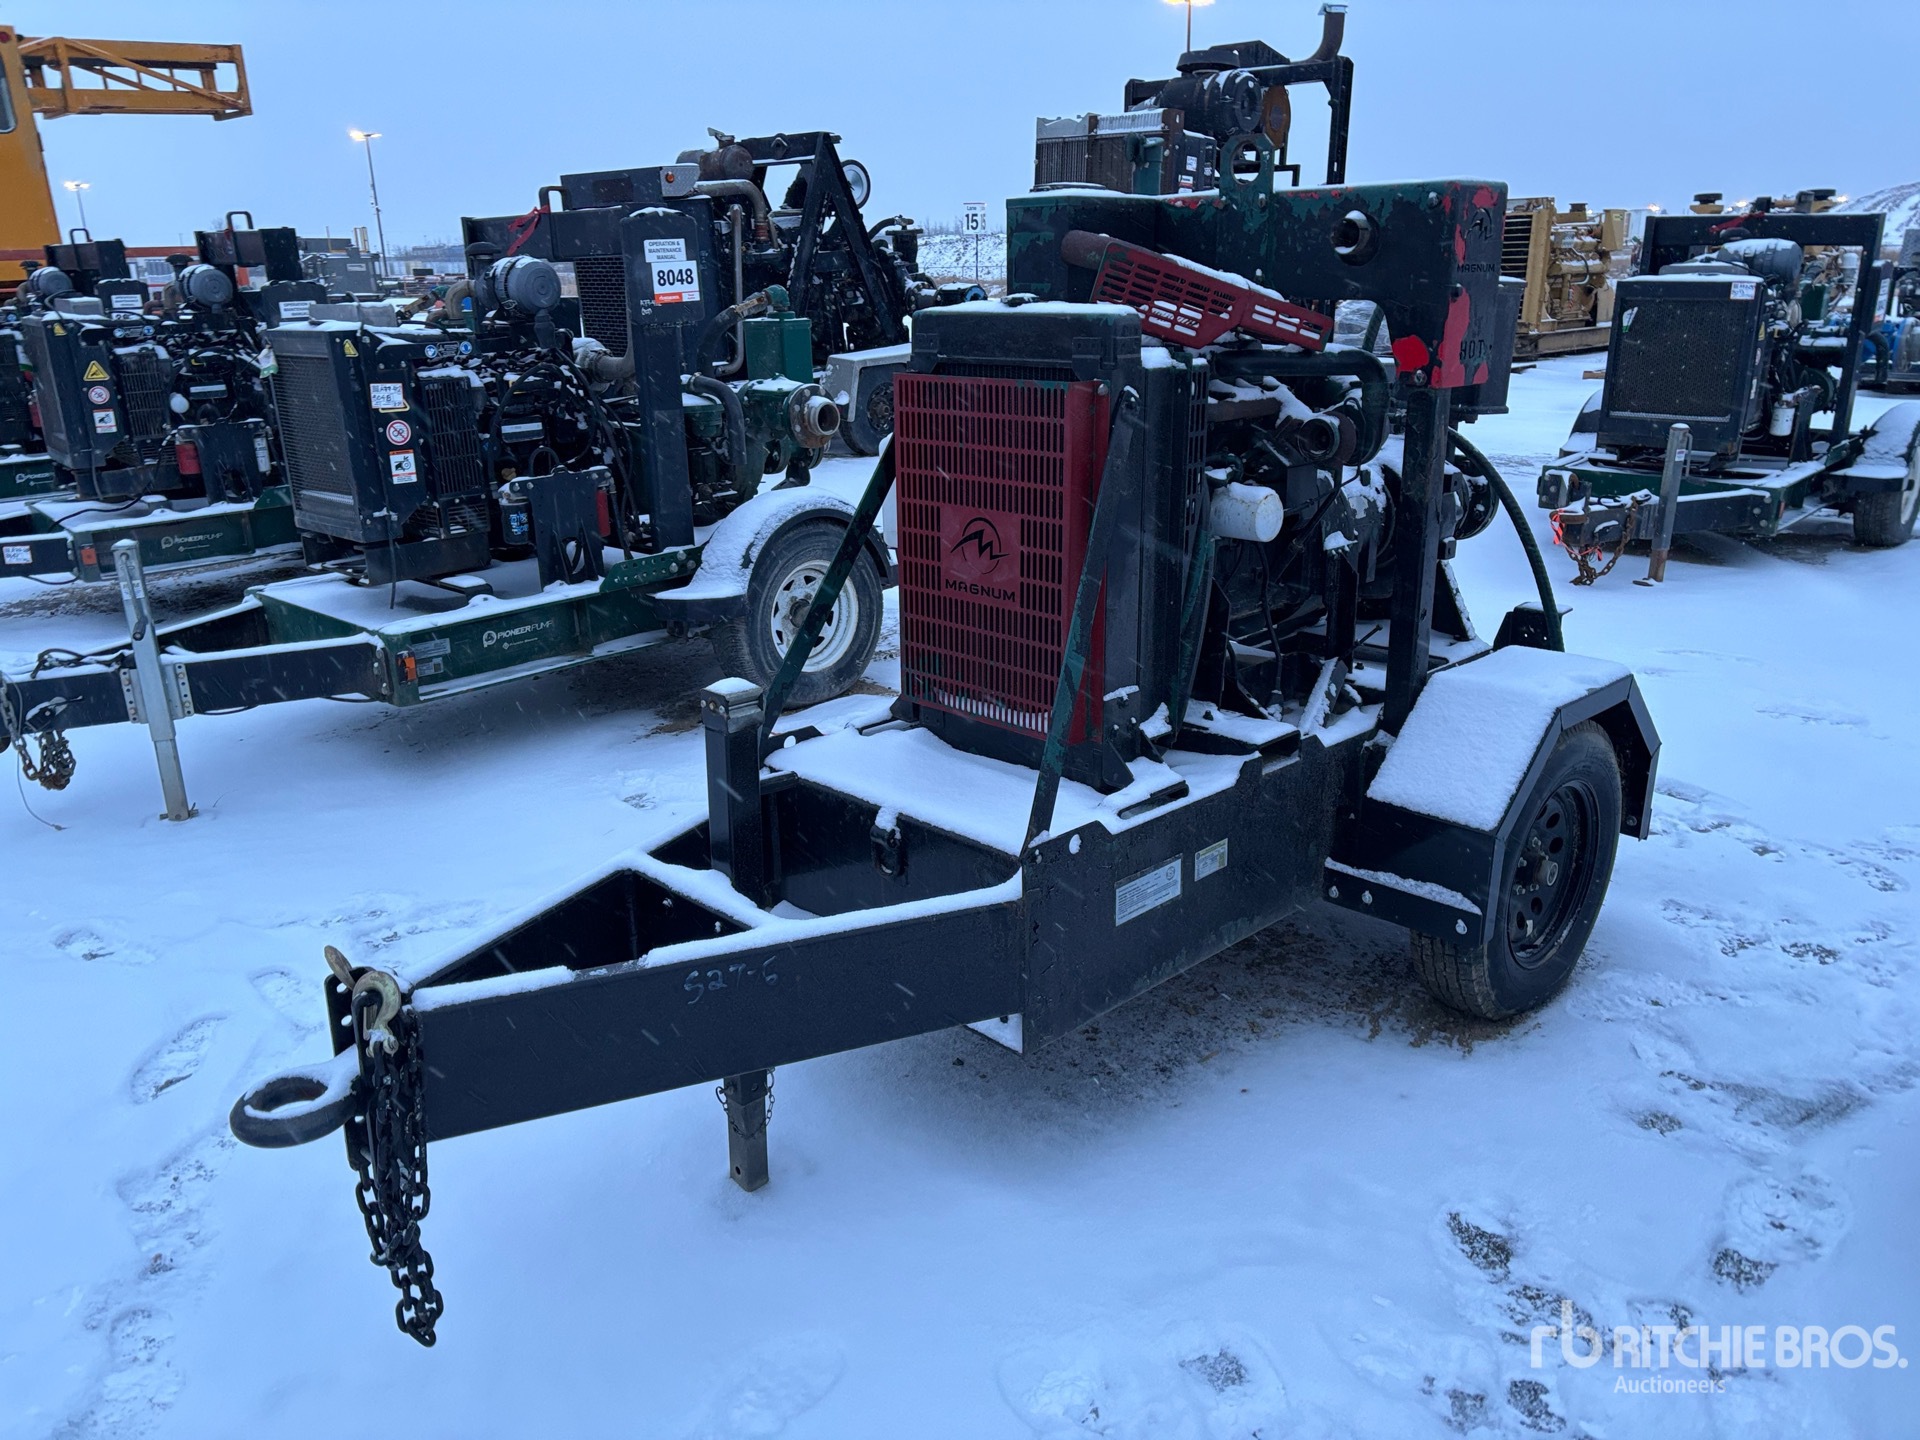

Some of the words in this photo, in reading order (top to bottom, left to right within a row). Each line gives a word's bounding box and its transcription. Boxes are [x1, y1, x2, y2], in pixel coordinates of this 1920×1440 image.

[965, 213, 979, 230] 15
[657, 268, 694, 287] 8048
[1457, 263, 1496, 274] MAGNUM
[945, 578, 1016, 603] MAGNUM
